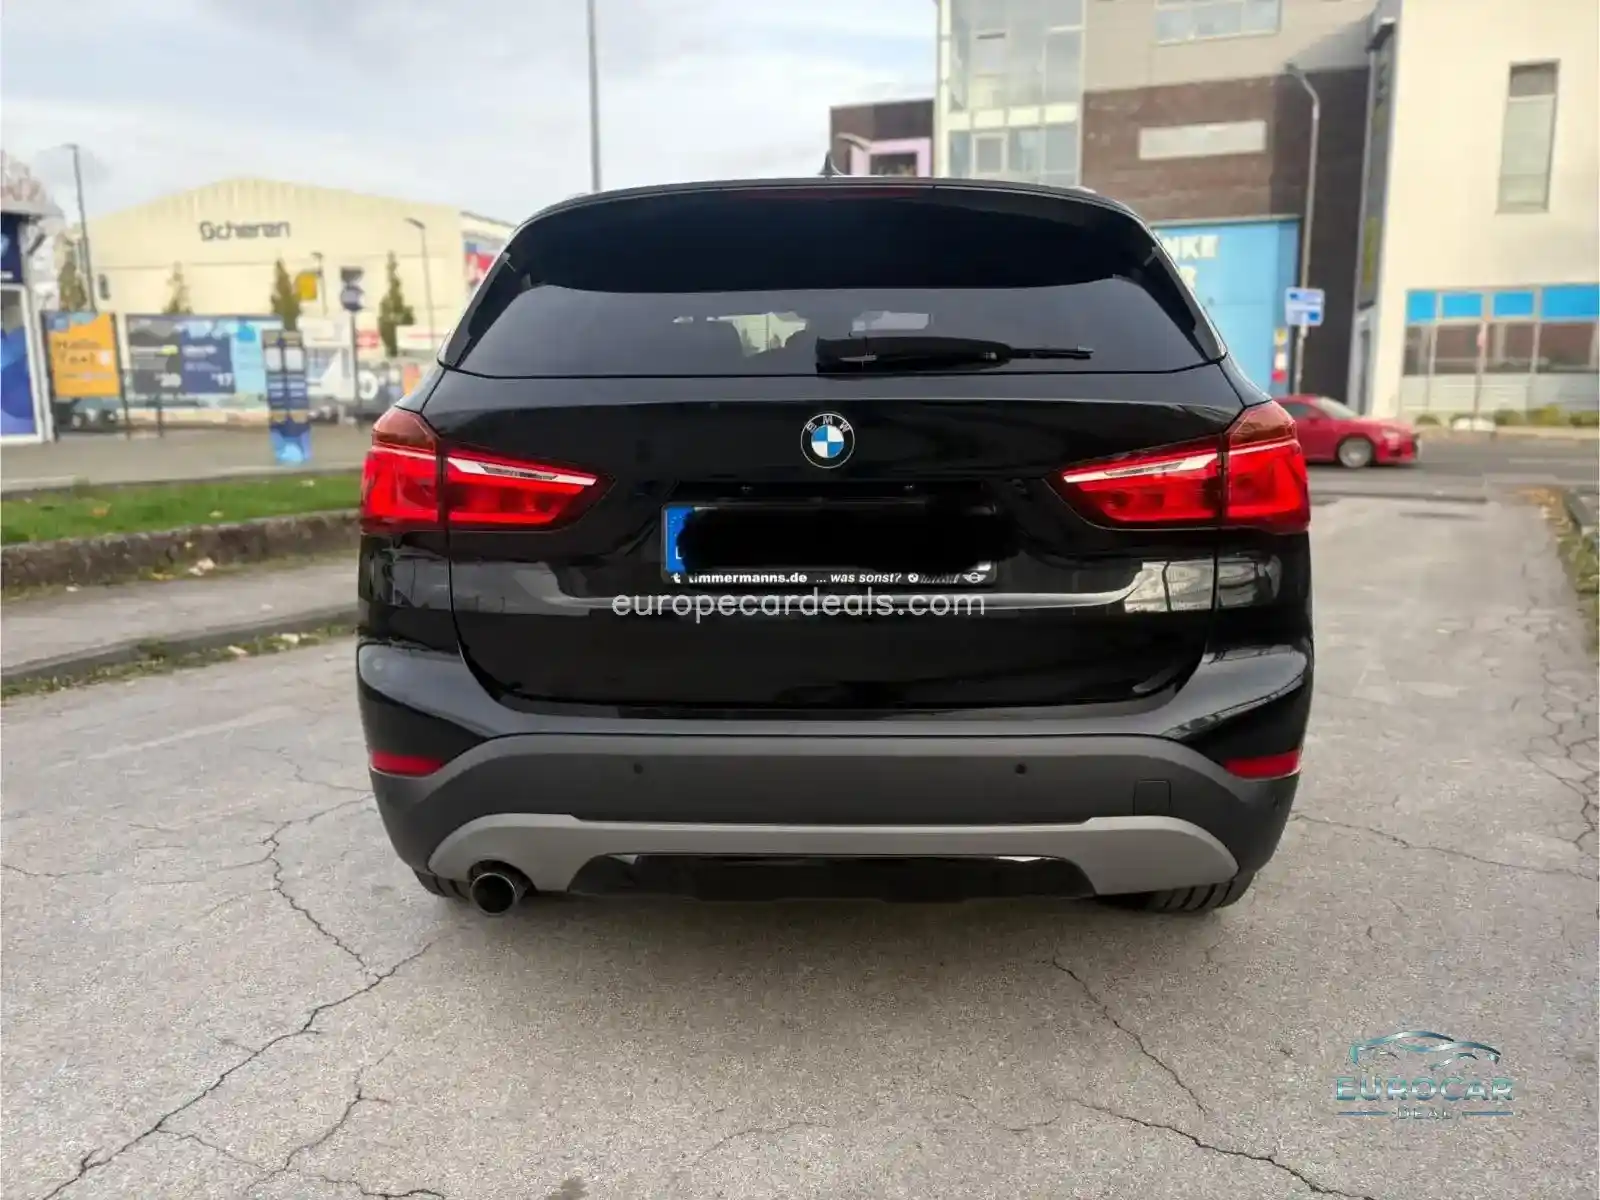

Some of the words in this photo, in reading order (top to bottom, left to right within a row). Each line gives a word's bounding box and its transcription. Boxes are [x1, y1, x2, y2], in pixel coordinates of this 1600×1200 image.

[806, 415, 851, 433] BMW
[830, 573, 855, 584] was
[859, 572, 902, 584] sonst?
